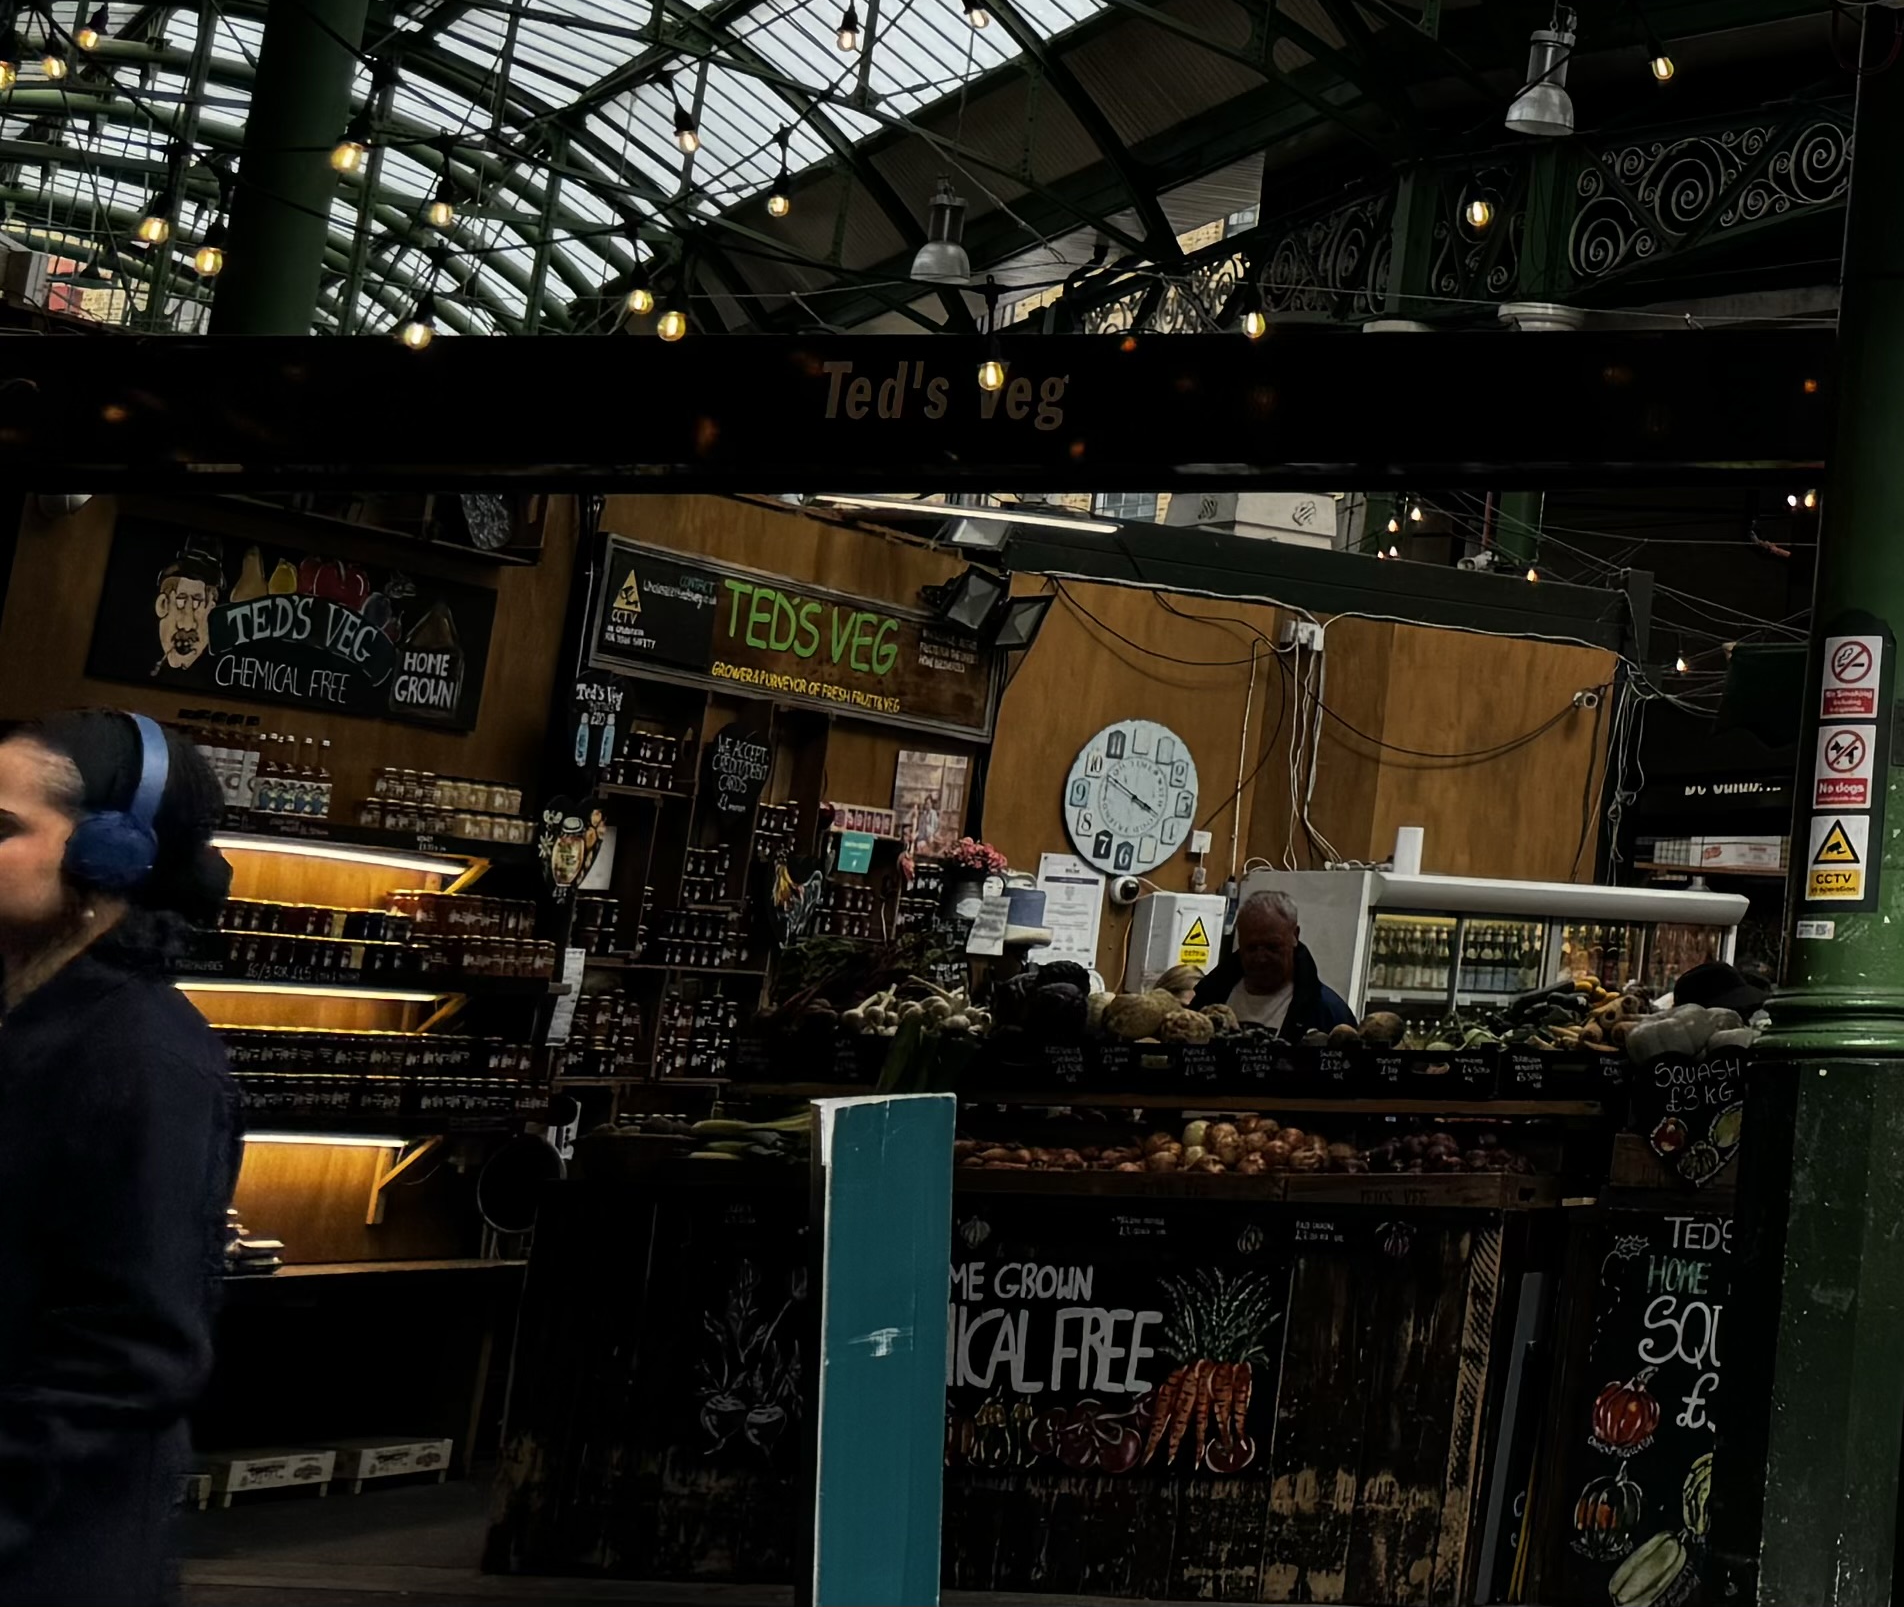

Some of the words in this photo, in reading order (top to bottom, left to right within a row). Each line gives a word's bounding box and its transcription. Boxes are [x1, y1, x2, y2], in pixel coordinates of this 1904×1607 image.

[823, 360, 950, 421] Ted's
[976, 360, 1070, 431] Veg
[227, 595, 316, 646] TED'S
[325, 602, 378, 663] VEG
[611, 608, 638, 625] CCTV
[723, 578, 824, 659] TED'S
[831, 604, 899, 676] VEG
[403, 650, 451, 678] HOME
[215, 655, 303, 697] CHEMICAL
[309, 669, 352, 705] FREE
[394, 675, 455, 710] GROWN
[1090, 755, 1103, 773] 10
[1076, 782, 1086, 802] 9
[1818, 783, 1834, 794] No
[1835, 782, 1866, 795] dogs
[1081, 811, 1092, 832] 8
[1097, 834, 1109, 856] 7
[1119, 846, 1130, 867] 6
[1816, 873, 1852, 885] CCTV
[1654, 1057, 1741, 1088] SQUASH
[1665, 1084, 1700, 1113] £3
[949, 1261, 986, 1302] ME
[993, 1261, 1094, 1302] GROWN
[1647, 1254, 1712, 1295] HOME
[947, 1302, 1044, 1393] ICAL
[1050, 1306, 1164, 1393] FREE
